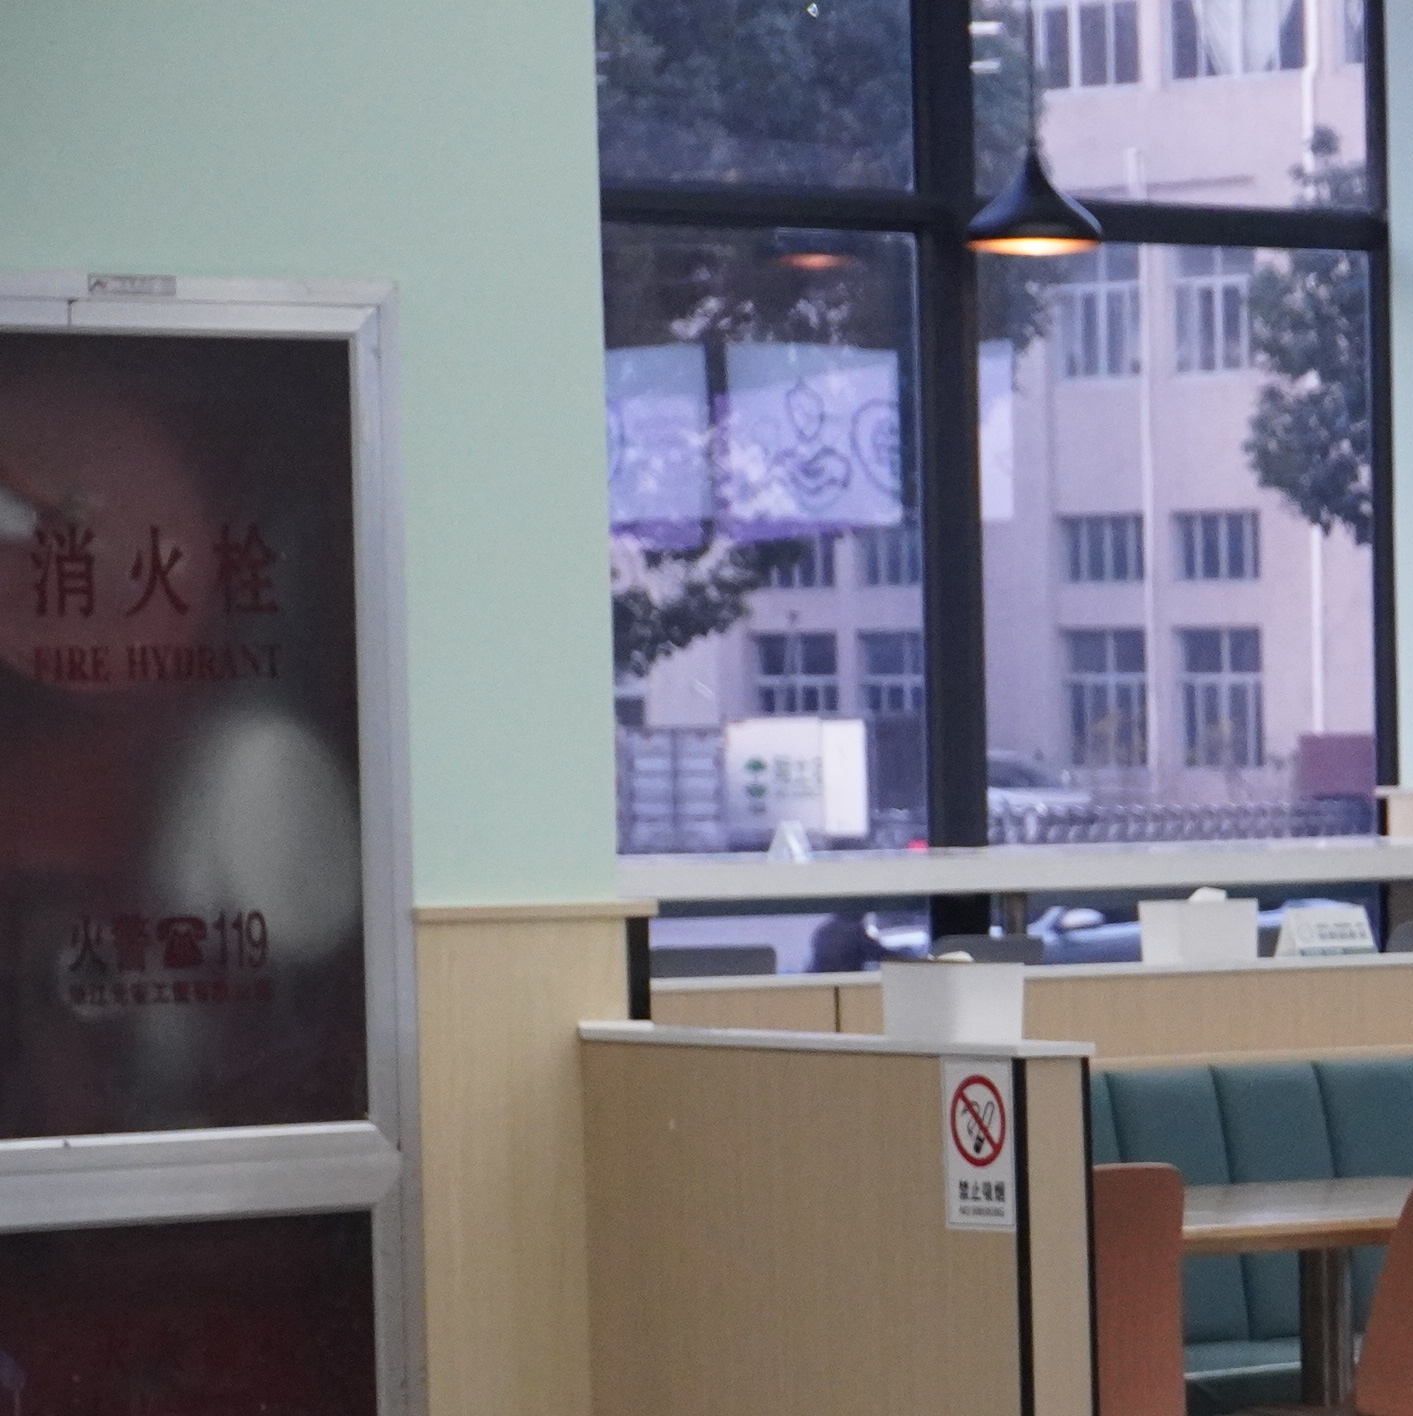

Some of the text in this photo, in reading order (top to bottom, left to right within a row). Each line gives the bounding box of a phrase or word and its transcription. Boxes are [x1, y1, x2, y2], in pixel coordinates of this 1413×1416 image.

[30, 521, 281, 617] 消火栓
[31, 644, 282, 682] FIRE HYDRANT
[67, 908, 269, 973] 火 119
